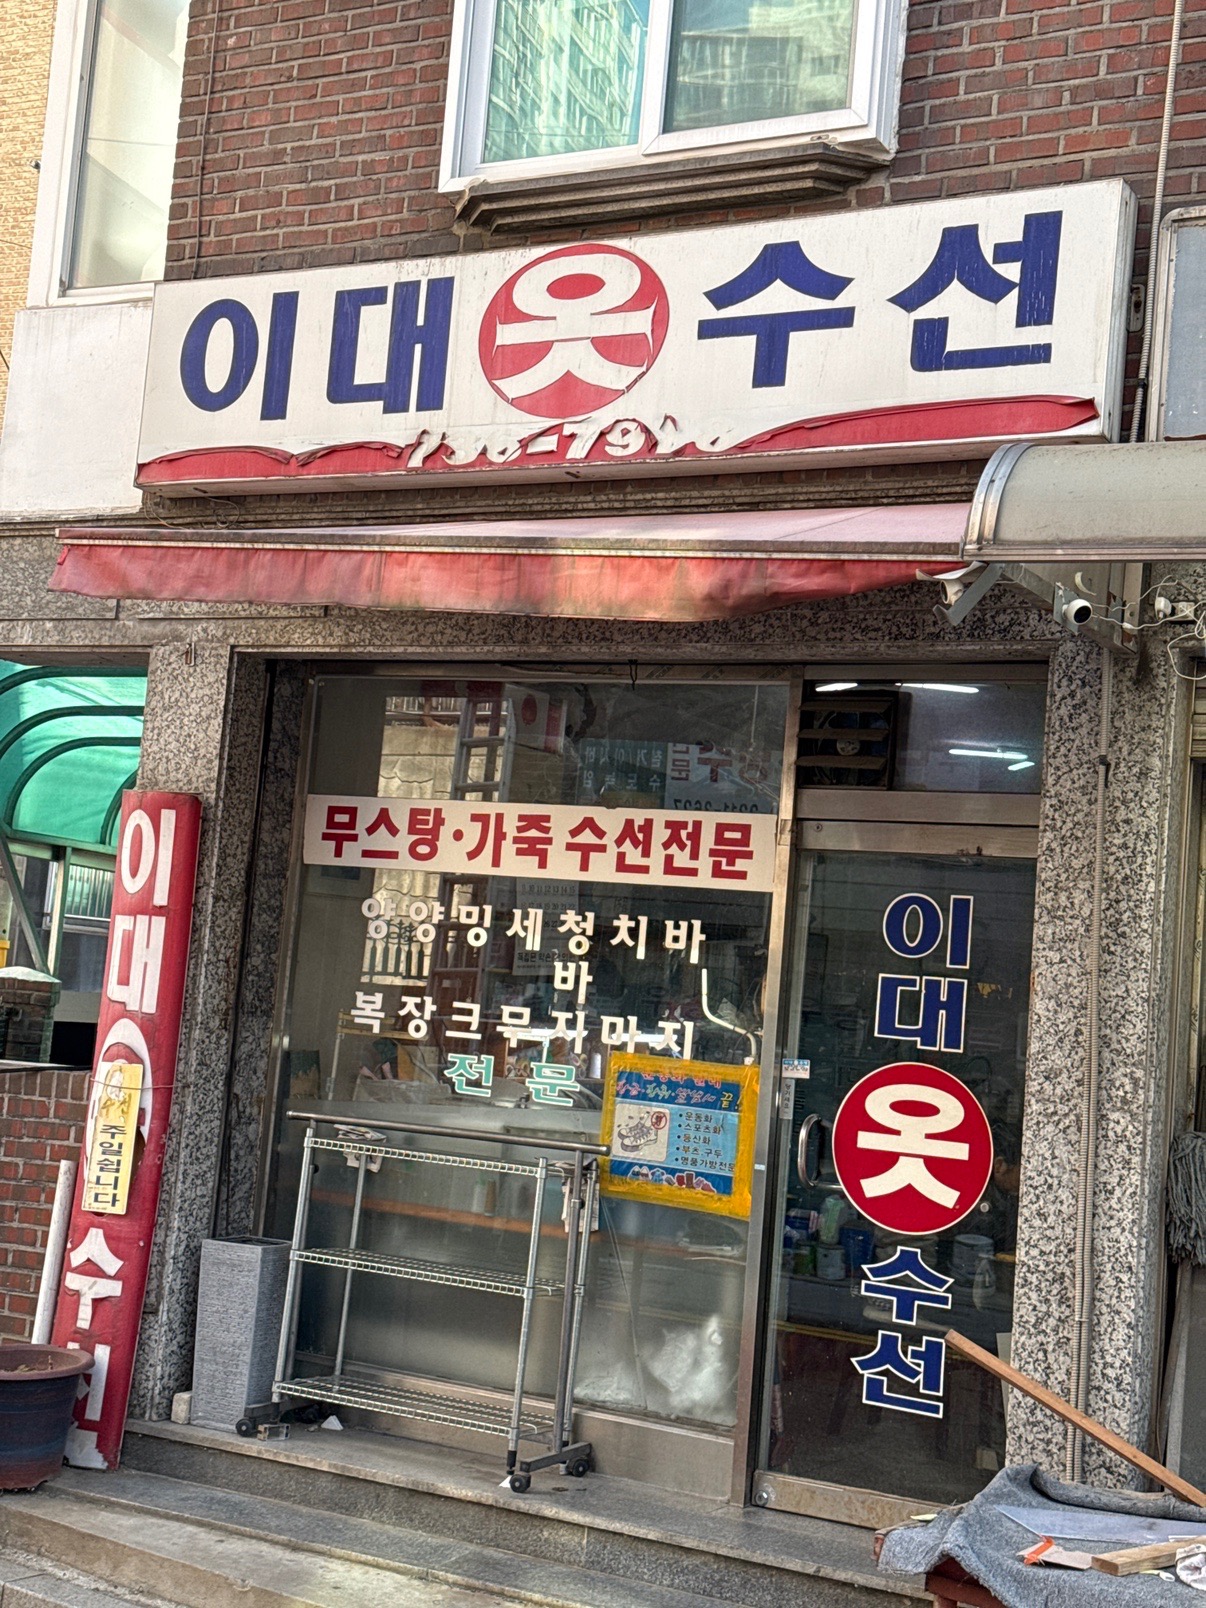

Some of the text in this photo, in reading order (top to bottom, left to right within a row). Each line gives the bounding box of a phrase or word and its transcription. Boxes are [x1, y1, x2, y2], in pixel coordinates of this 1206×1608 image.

[179, 209, 1064, 421] 이대 옷 수선
[107, 808, 177, 1014] 이대
[873, 893, 974, 1053] 이대
[683, 1123, 722, 1135] 스포츠화
[684, 1111, 713, 1124] 운동화
[856, 1083, 970, 1210] 옷
[850, 1245, 954, 1419] 수선
